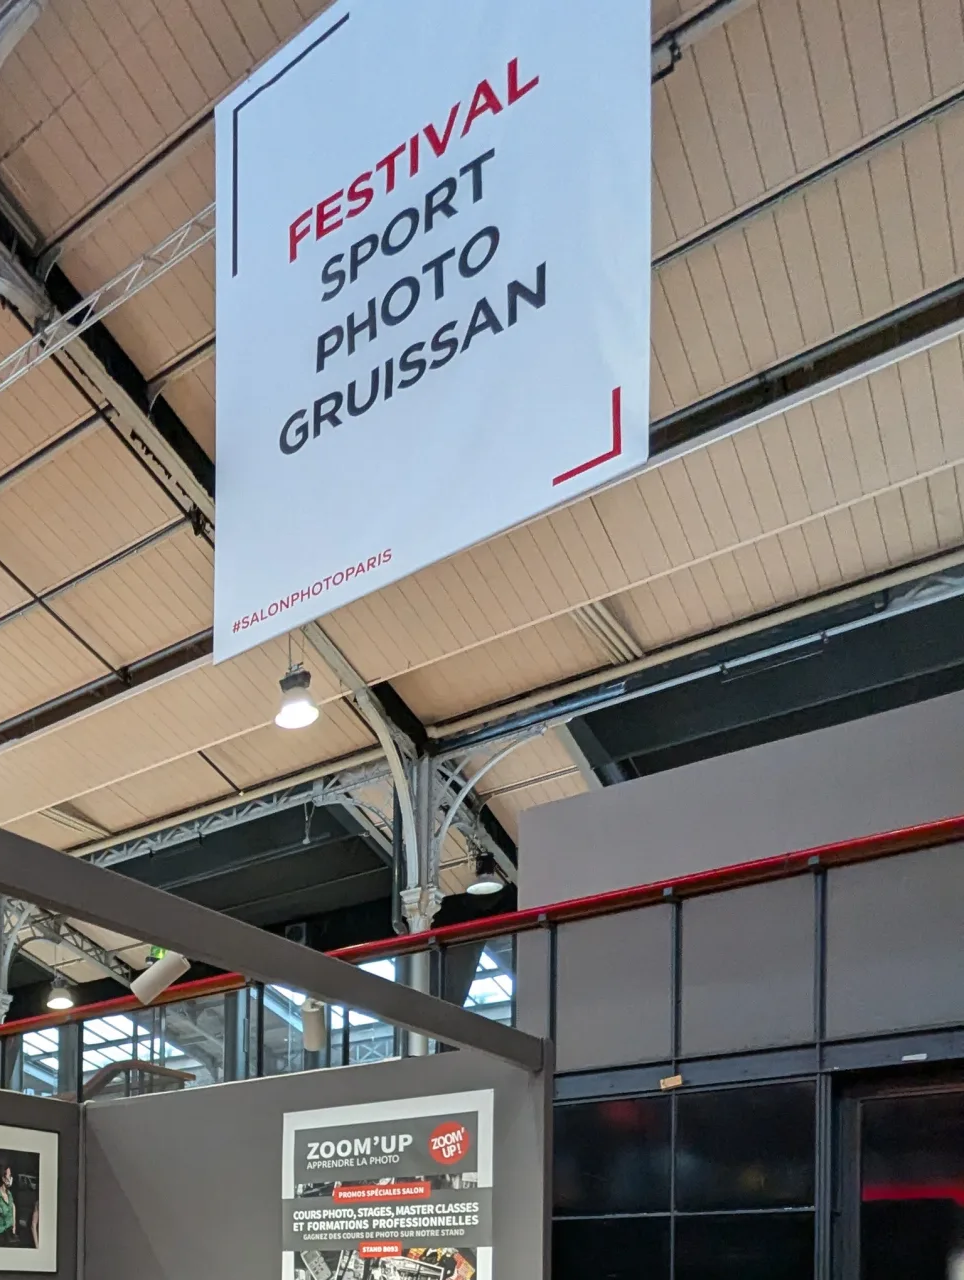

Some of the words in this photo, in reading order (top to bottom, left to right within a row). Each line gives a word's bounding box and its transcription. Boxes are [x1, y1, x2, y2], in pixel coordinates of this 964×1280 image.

[289, 57, 540, 263] FESTIVAL
[320, 149, 495, 302] SPORT
[315, 225, 500, 374] PHOTO
[279, 261, 547, 456] GRUISSAN
[232, 549, 393, 634] #SALONPHOTOPARIS
[431, 1127, 465, 1150] ZOOM'
[442, 1143, 462, 1159] UP!
[306, 1158, 355, 1170] APPRENDRE
[357, 1156, 368, 1166] LA
[369, 1154, 400, 1165] PHOTO
[338, 1190, 366, 1199] PROMOS
[367, 1187, 401, 1198] SPÉCIALES
[402, 1186, 424, 1195] SALON
[293, 1209, 322, 1221] COURS
[322, 1207, 357, 1220] PHOTO,
[357, 1205, 395, 1218] STAGES,
[395, 1203, 434, 1216] MASTER
[435, 1202, 479, 1215] CLASSES
[293, 1221, 304, 1232] ET
[307, 1218, 369, 1231] FORMATIONS
[372, 1214, 479, 1229] PROFESSIONNELLES
[303, 1233, 328, 1241] GAGNEZ
[329, 1232, 341, 1240] DES
[342, 1232, 364, 1240] COURS
[365, 1231, 375, 1239] DE
[375, 1230, 399, 1239] PHOTO
[400, 1229, 414, 1238] SUR
[415, 1229, 439, 1237] NOTRE
[440, 1228, 465, 1237] STAND
